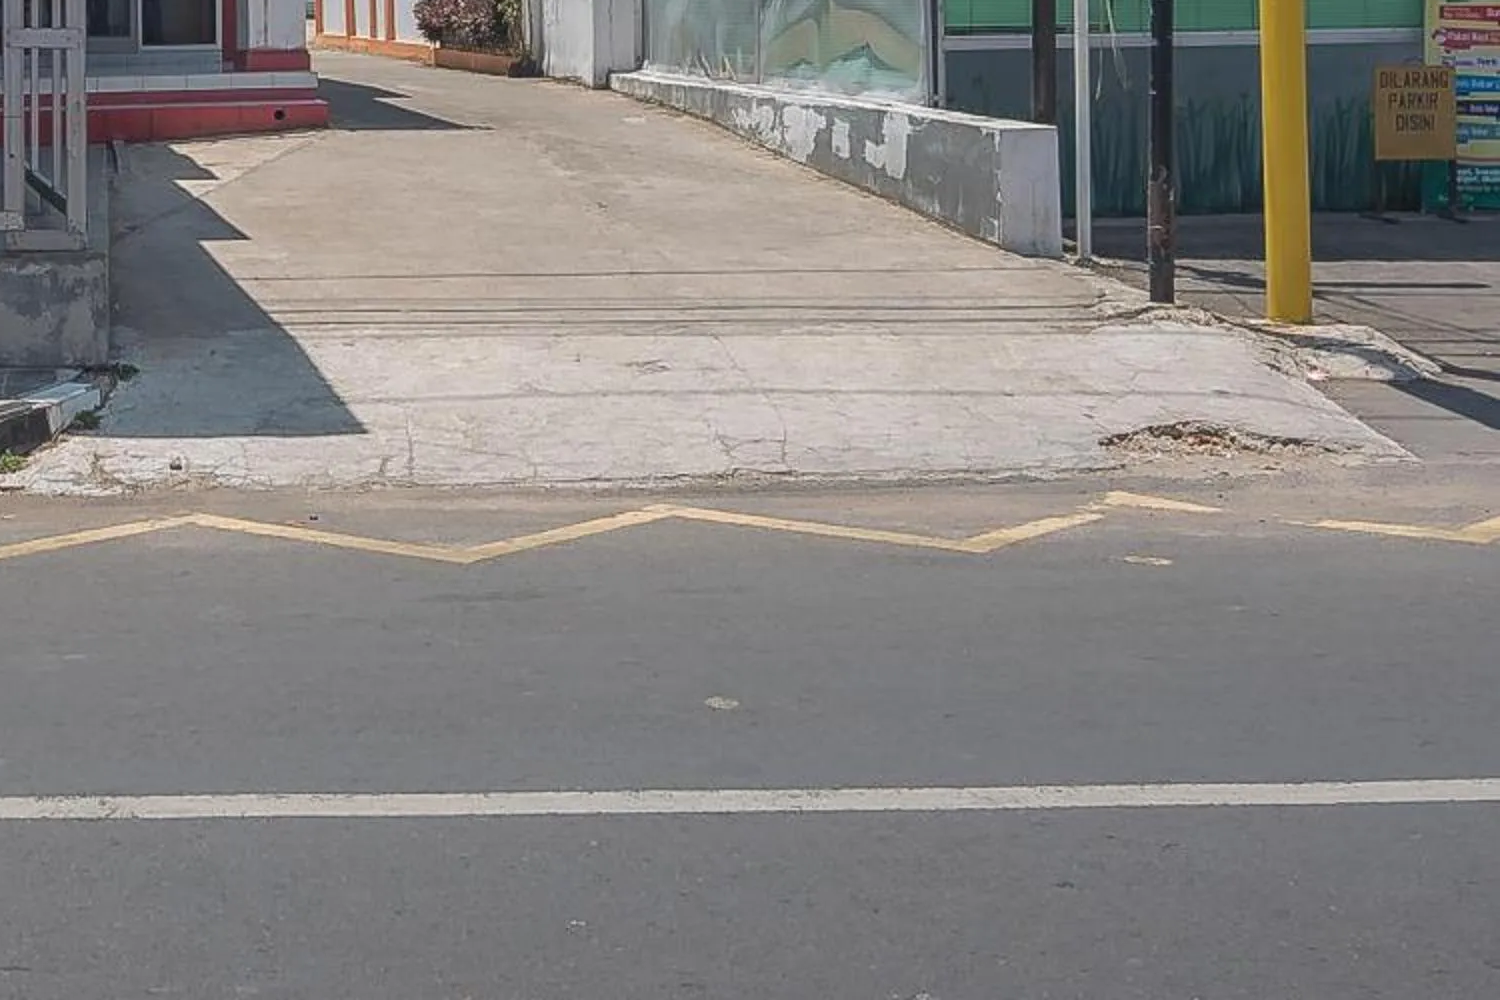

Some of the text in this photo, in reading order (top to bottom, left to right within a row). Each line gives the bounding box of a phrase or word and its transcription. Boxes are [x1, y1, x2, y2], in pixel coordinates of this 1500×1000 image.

[1379, 71, 1449, 89] DILARANG
[1388, 92, 1439, 110] PARKIR
[1395, 114, 1435, 132] DISINI
